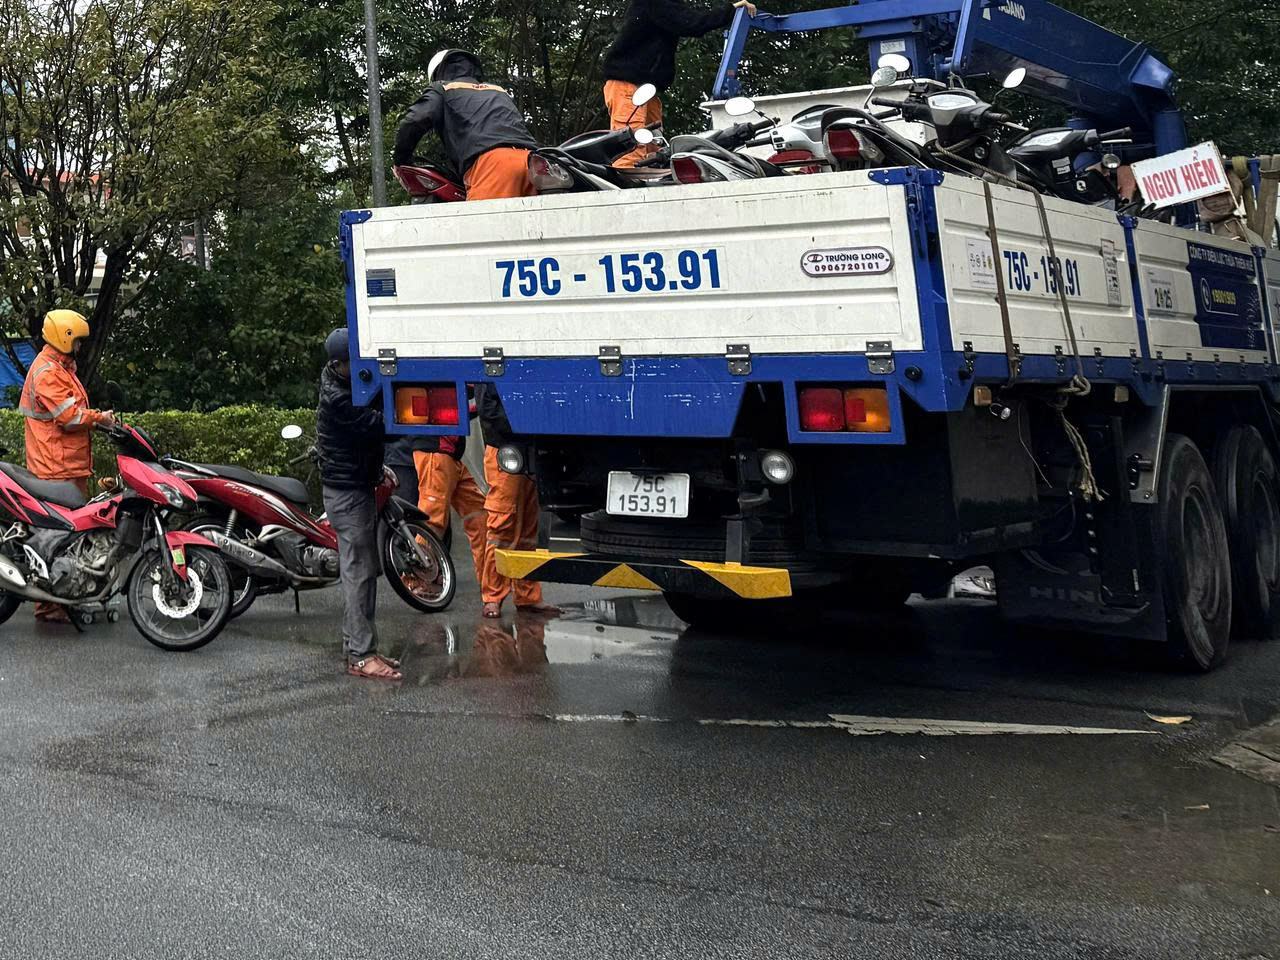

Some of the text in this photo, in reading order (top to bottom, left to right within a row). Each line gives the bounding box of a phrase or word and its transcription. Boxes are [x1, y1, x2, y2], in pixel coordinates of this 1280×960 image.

[998, 0, 1026, 21] ADANO
[1142, 150, 1221, 201] NGUY HIỂM
[814, 262, 879, 272] 0906720101
[825, 252, 885, 262] TRƯỜNG LONG
[495, 257, 561, 297] 75C
[598, 249, 721, 293] 153.91
[1003, 250, 1031, 292] 75C
[632, 476, 665, 493] 75C
[619, 494, 677, 514] 153.91
